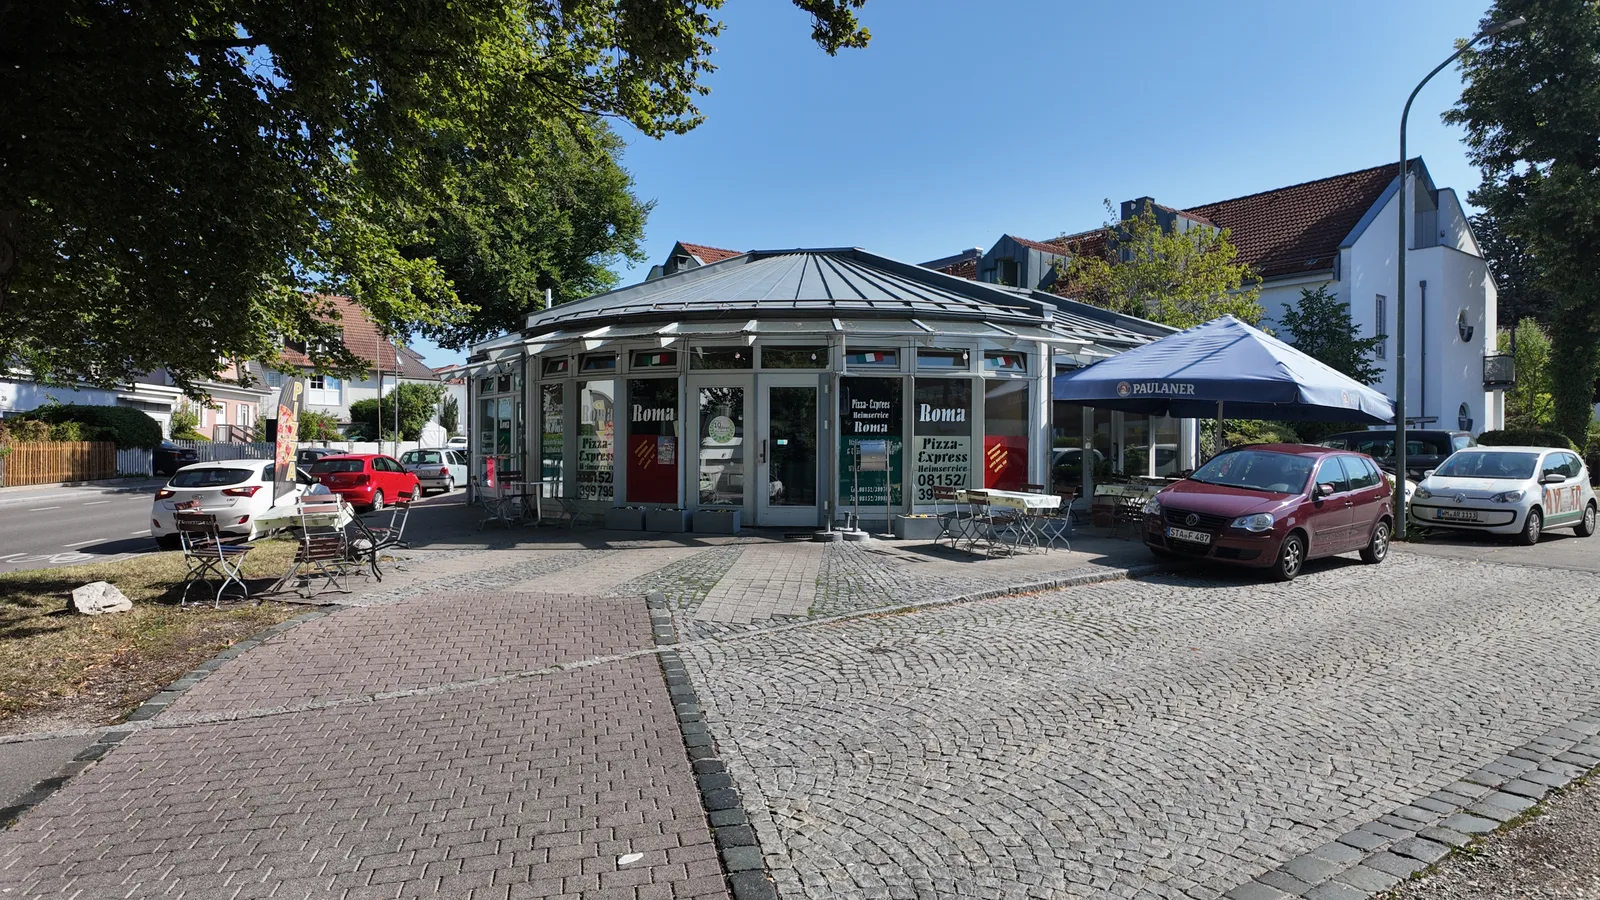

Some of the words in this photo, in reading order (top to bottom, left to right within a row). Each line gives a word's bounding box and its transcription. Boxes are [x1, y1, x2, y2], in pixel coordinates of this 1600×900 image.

[1132, 382, 1195, 395] PAULANER
[582, 404, 613, 421] Roma
[632, 404, 674, 422] Roma
[853, 411, 889, 419] Heimservice
[919, 403, 966, 422] Roma
[285, 381, 303, 481] PIZZA
[854, 421, 888, 433] Roma
[582, 437, 611, 449] Pizza-
[922, 437, 963, 450] Pizza-
[579, 450, 613, 463] Express
[918, 451, 968, 464] Express
[918, 465, 968, 473] Heimservice
[918, 473, 967, 487] 08152/
[1170, 528, 1184, 538] STA
[1194, 533, 1210, 542] 487
